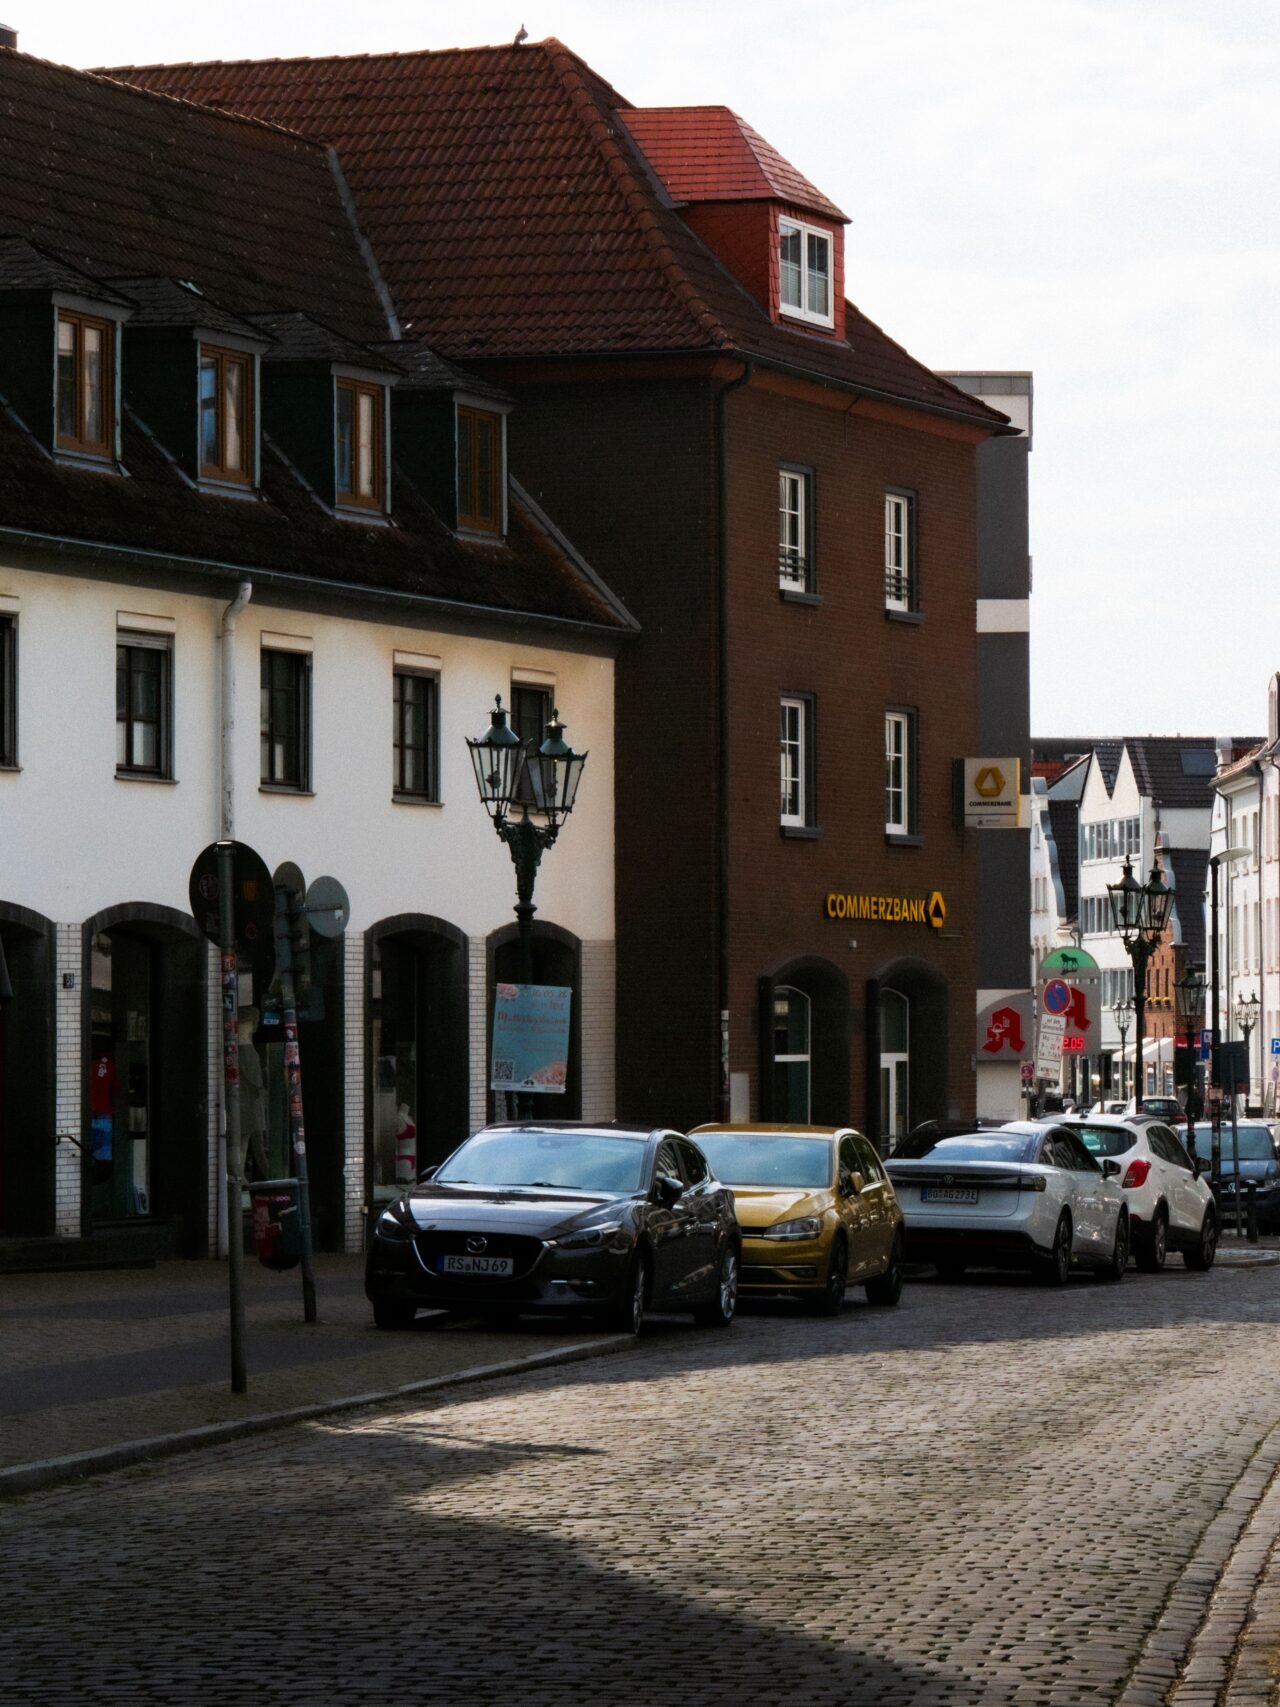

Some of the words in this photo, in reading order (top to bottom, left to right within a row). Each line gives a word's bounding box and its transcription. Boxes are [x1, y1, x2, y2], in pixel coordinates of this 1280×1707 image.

[827, 893, 926, 922] COMMERZBANK
[1273, 1040, 1280, 1052] P
[447, 1257, 464, 1270] RS
[472, 1258, 489, 1272] NJ
[491, 1260, 508, 1273] 69
